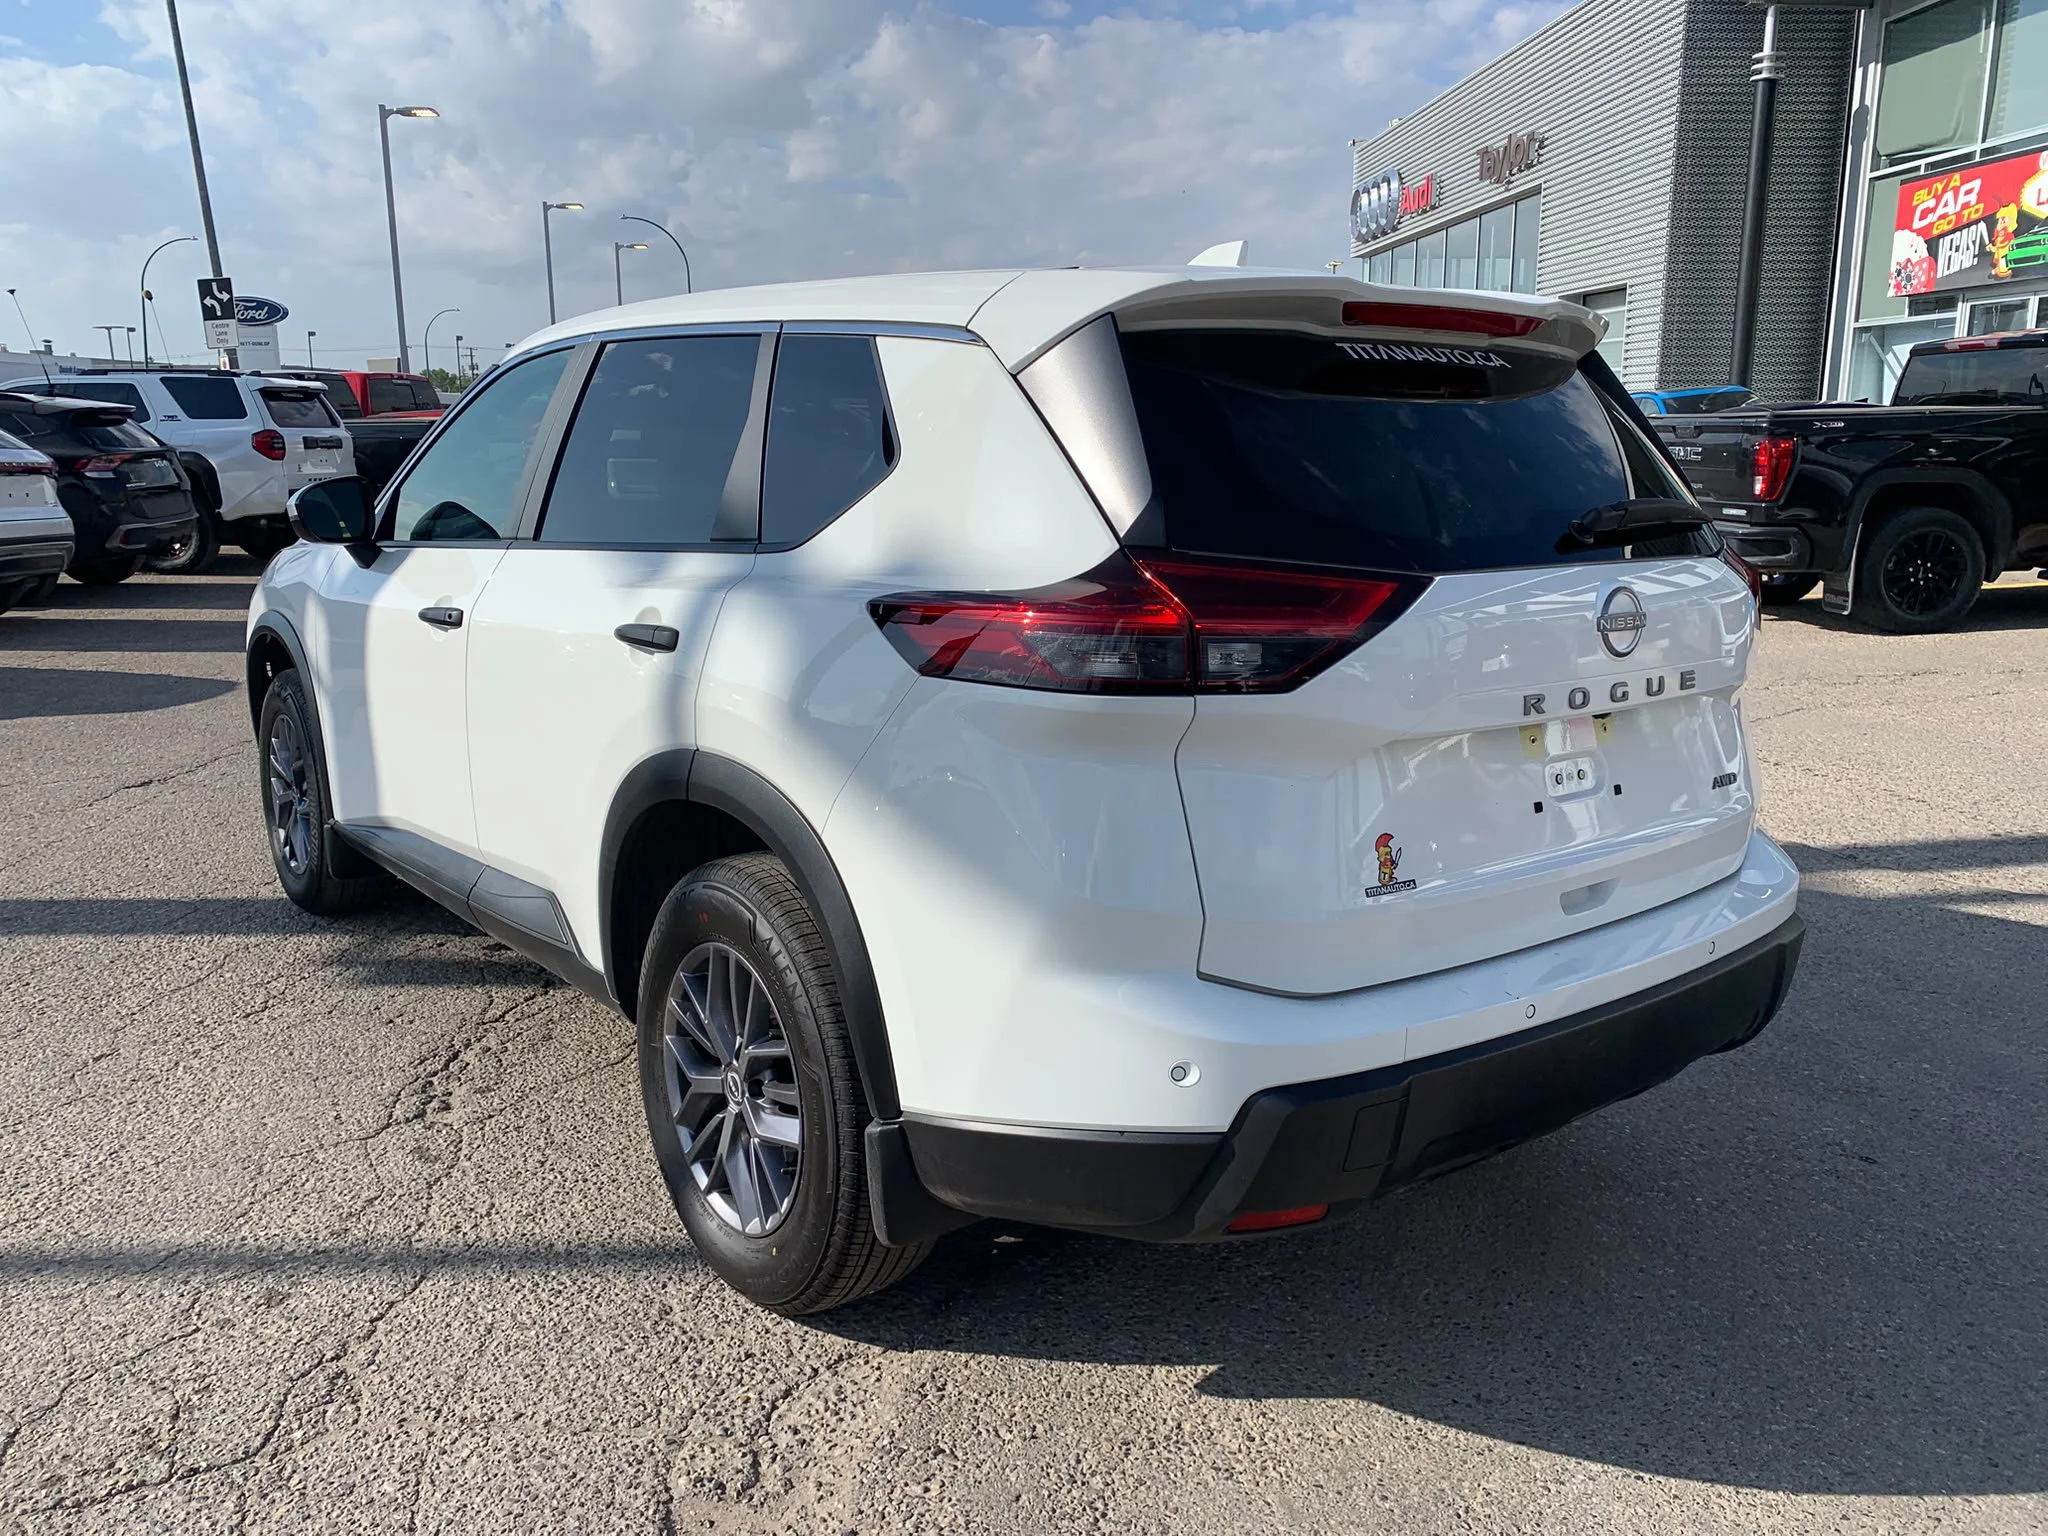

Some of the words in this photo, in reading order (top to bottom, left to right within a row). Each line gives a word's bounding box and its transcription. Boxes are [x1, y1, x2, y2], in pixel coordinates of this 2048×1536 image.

[1476, 131, 1538, 184] Taylor
[1401, 173, 1434, 216] Audi
[1912, 178, 1948, 206] BUY
[1947, 173, 1961, 191] A
[1912, 178, 1982, 230] CAR
[1932, 214, 1957, 235] GO
[1962, 203, 1985, 222] TO
[1937, 223, 1981, 279] VEGAS!
[234, 301, 269, 319] Ford
[1335, 342, 1513, 369] TITANAUTO.CA
[1523, 669, 1697, 717] ROGUE
[1711, 771, 1738, 790] AWD
[1366, 880, 1416, 897] TITANAUTO.CA
